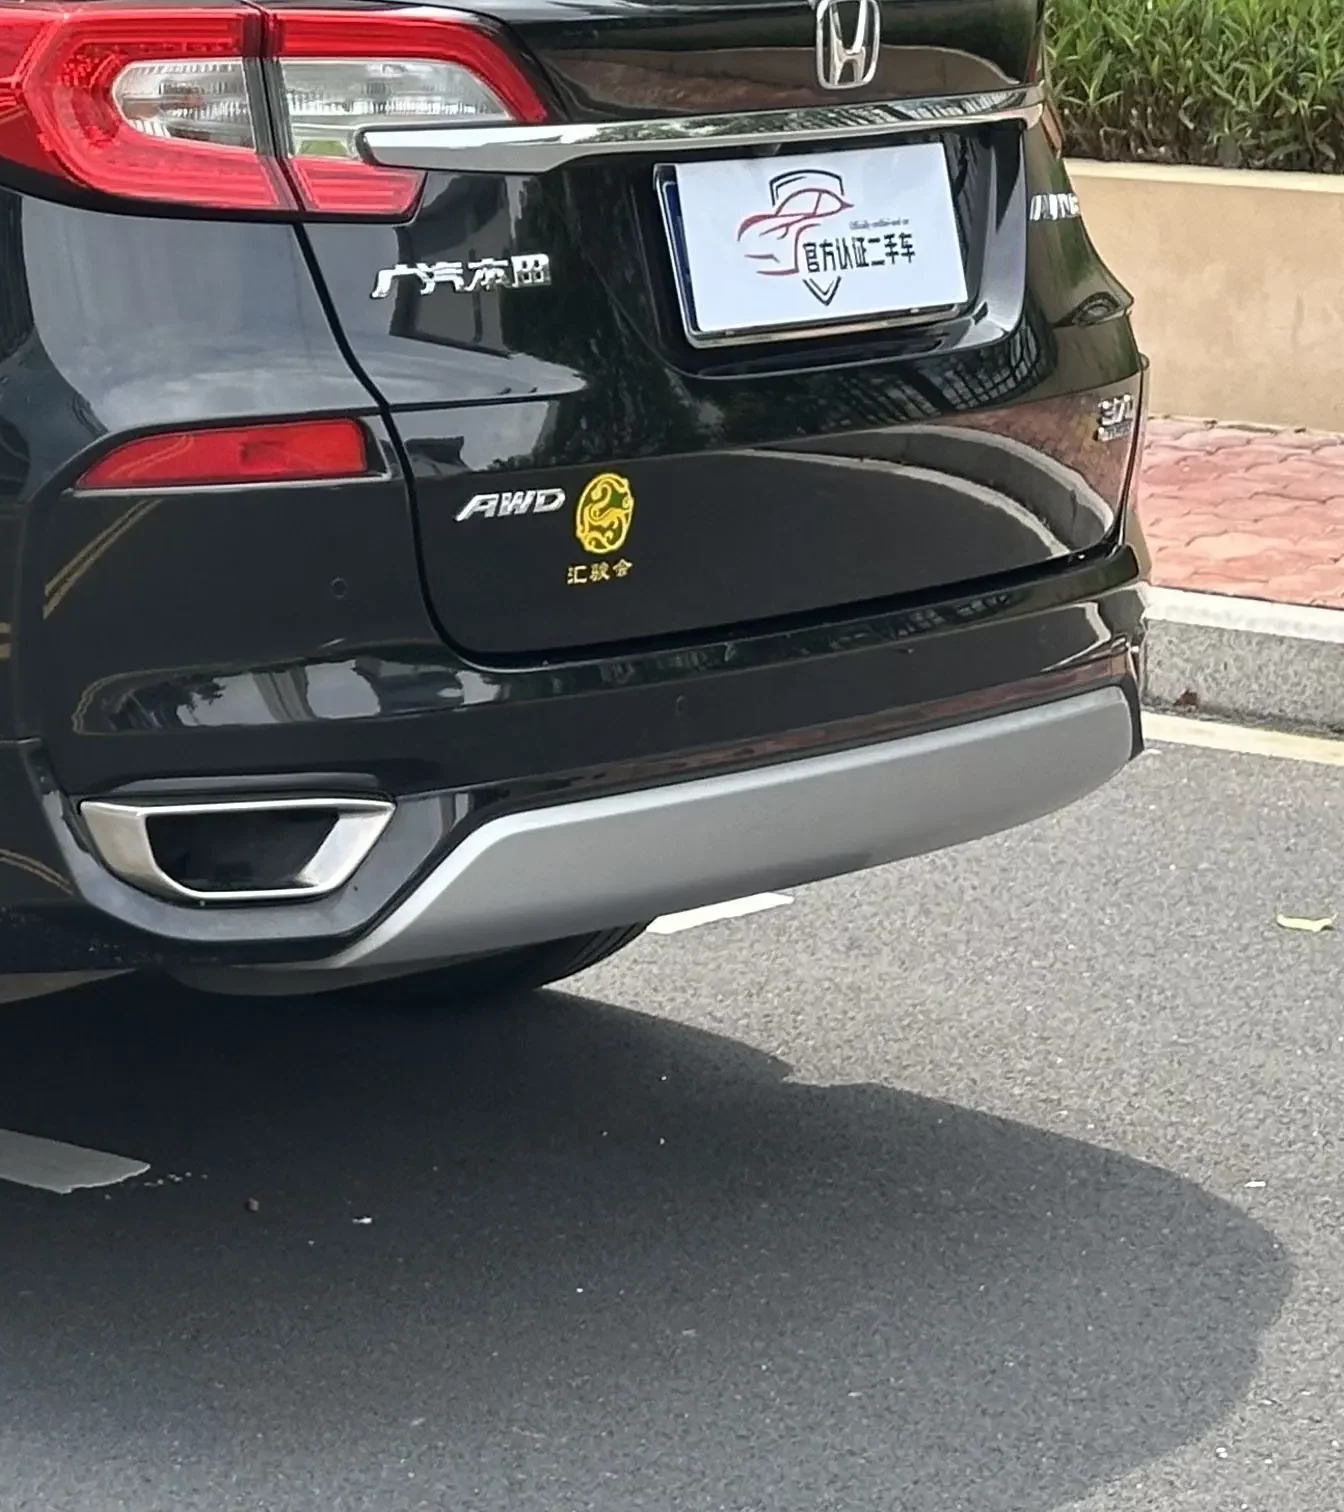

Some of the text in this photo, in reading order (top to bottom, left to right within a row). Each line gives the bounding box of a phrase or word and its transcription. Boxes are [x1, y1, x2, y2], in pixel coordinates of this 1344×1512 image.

[802, 232, 916, 274] 官方认证二手车
[370, 253, 551, 299] 广汽本田
[455, 487, 567, 523] AWD
